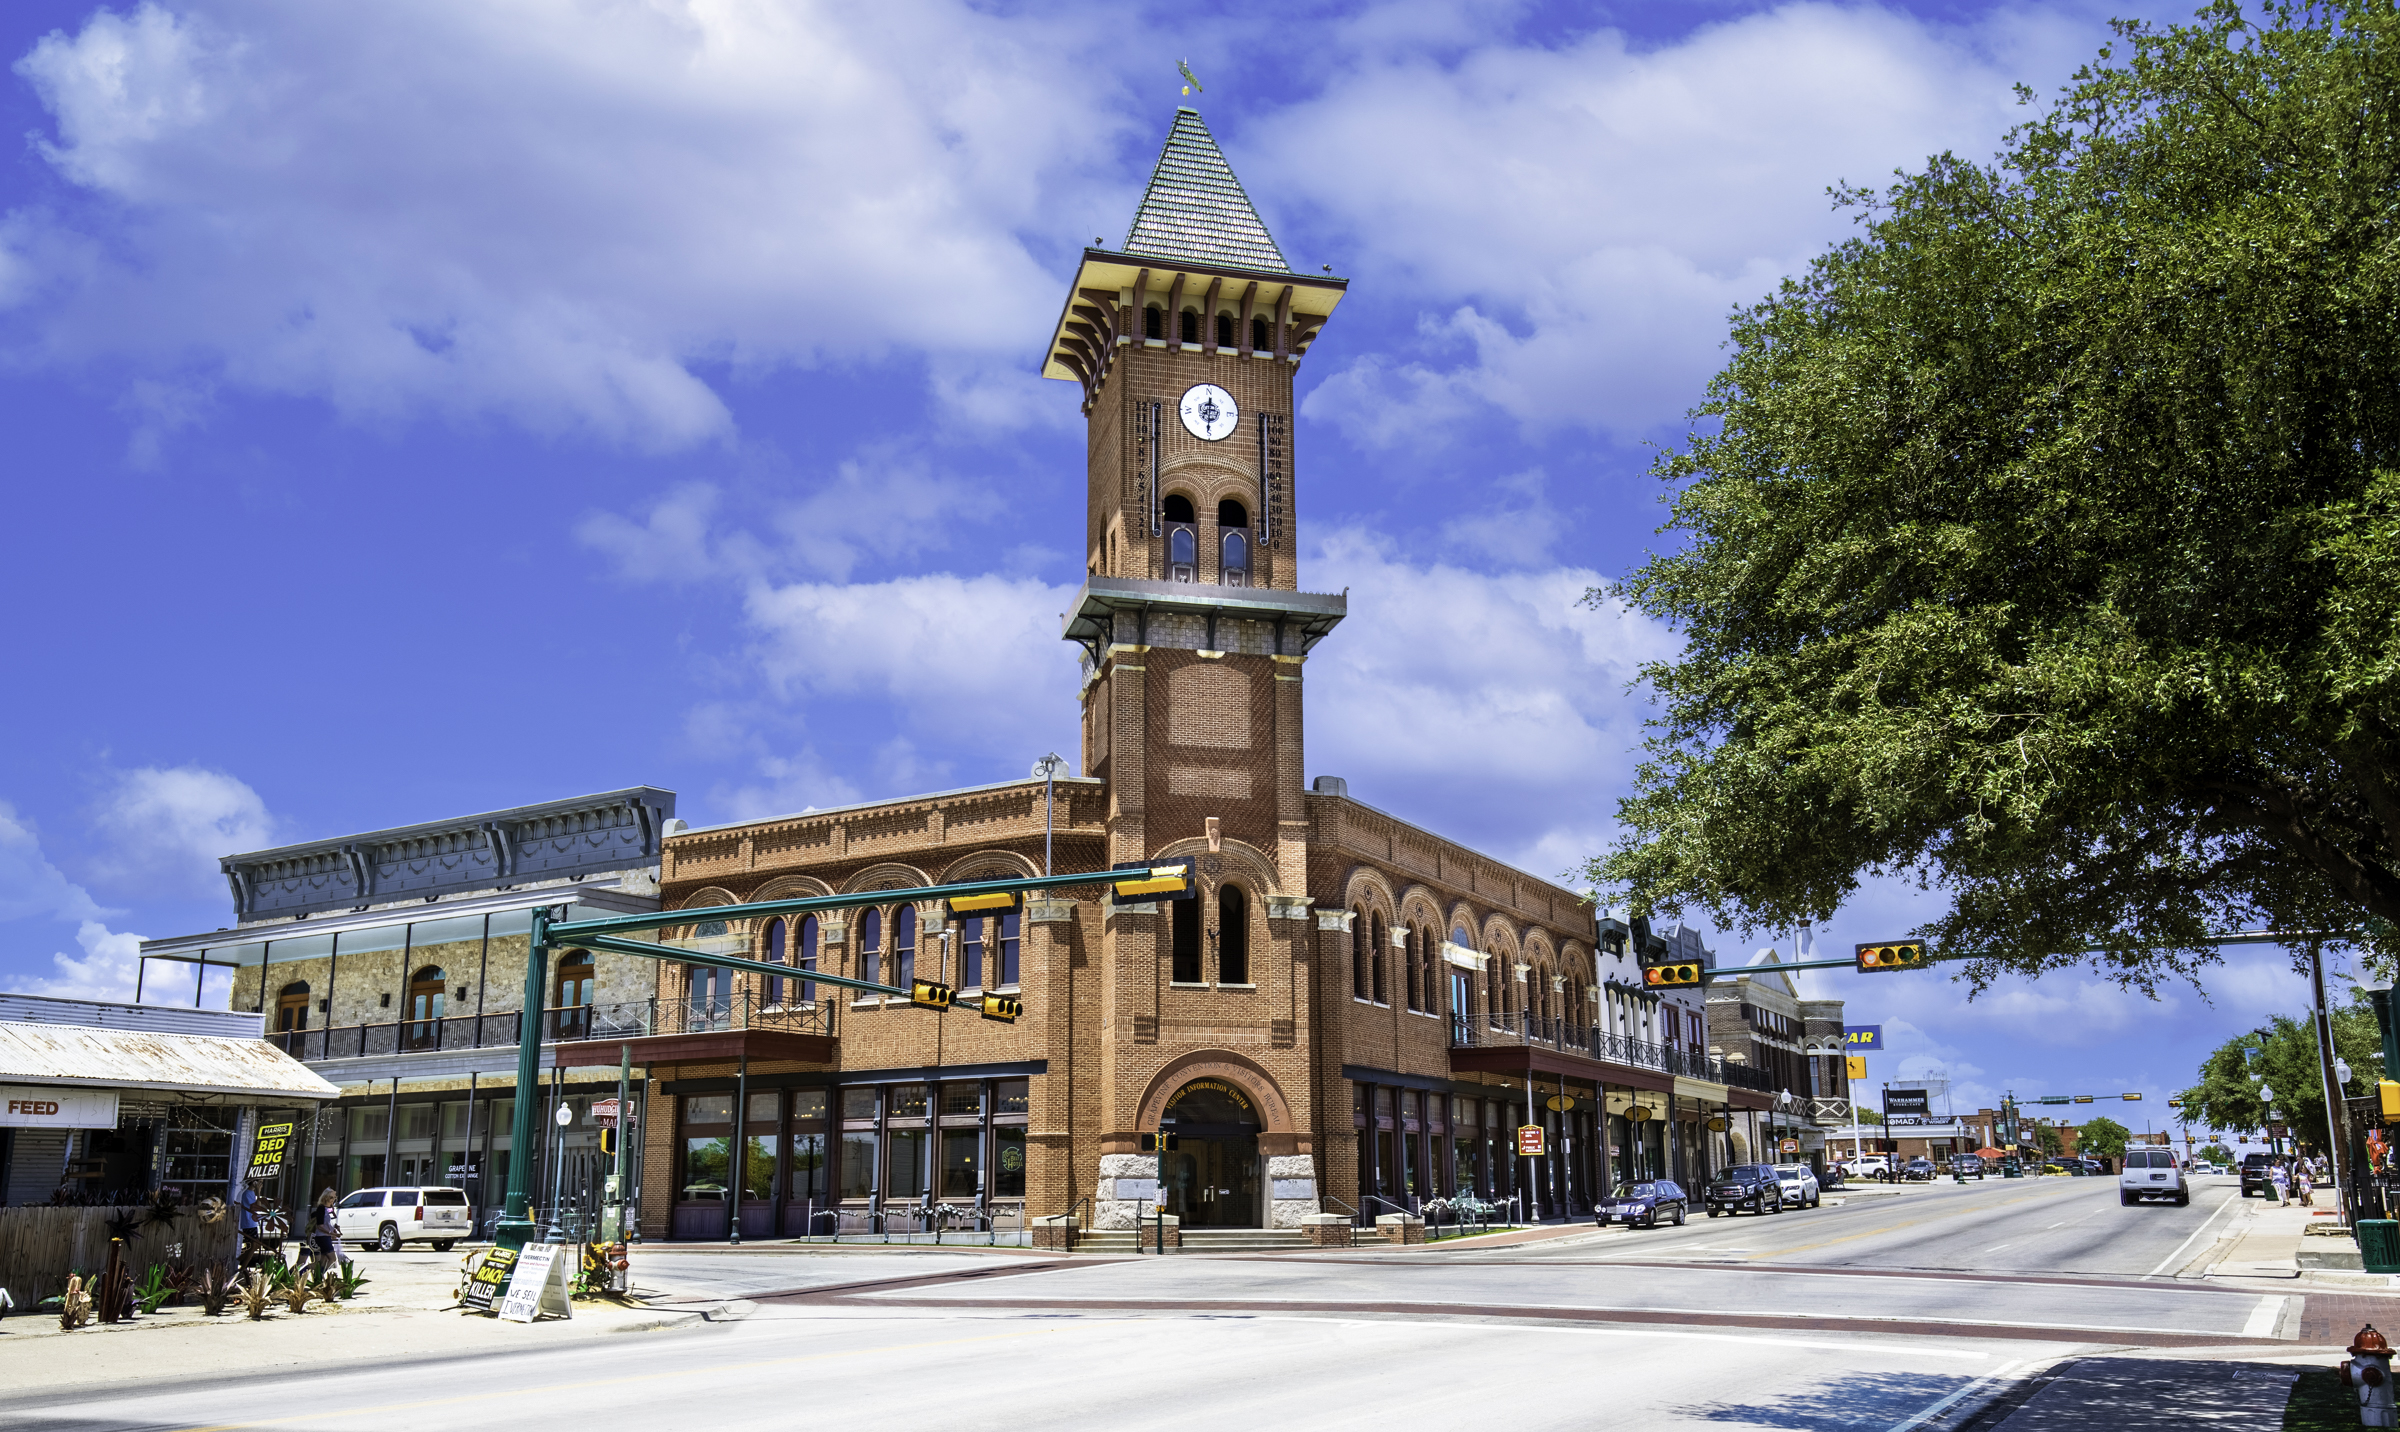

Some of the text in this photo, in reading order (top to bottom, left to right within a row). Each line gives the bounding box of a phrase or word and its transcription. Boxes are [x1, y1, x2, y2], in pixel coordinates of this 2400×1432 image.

[1136, 402, 1147, 411] 12
[1137, 413, 1146, 421] 11
[1267, 415, 1283, 424] 110
[1137, 425, 1148, 433] 10
[1267, 426, 1283, 435] 100
[1270, 438, 1281, 446] 90
[1139, 448, 1144, 456] 8
[1270, 449, 1281, 458] 80
[1139, 460, 1144, 468] 7
[1270, 460, 1281, 469] 70
[1139, 471, 1144, 479] 6
[1139, 482, 1144, 491] 5
[1270, 483, 1281, 491] 50
[1139, 494, 1144, 502] 4
[1270, 494, 1281, 503] 40
[1139, 505, 1144, 515] 3
[1270, 506, 1282, 514] 30
[1139, 518, 1144, 527] 2
[1270, 517, 1282, 526] 20
[1139, 530, 1143, 538] 1
[1271, 529, 1282, 537] 10
[1274, 540, 1279, 549] 0
[1147, 1062, 1280, 1126] GRAPEVINE CONVENTION & VISITORS BUREAU
[1165, 1082, 1249, 1109] VISITOR INFORMATION CENTER
[8, 1100, 59, 1115] FEED
[264, 1126, 287, 1134] HARRIS
[259, 1138, 285, 1151] BED
[253, 1152, 282, 1165] BUG
[248, 1164, 280, 1178] KILLER
[476, 1266, 505, 1284] ROACH
[469, 1281, 497, 1300] KILLER
[510, 1289, 521, 1298] WE
